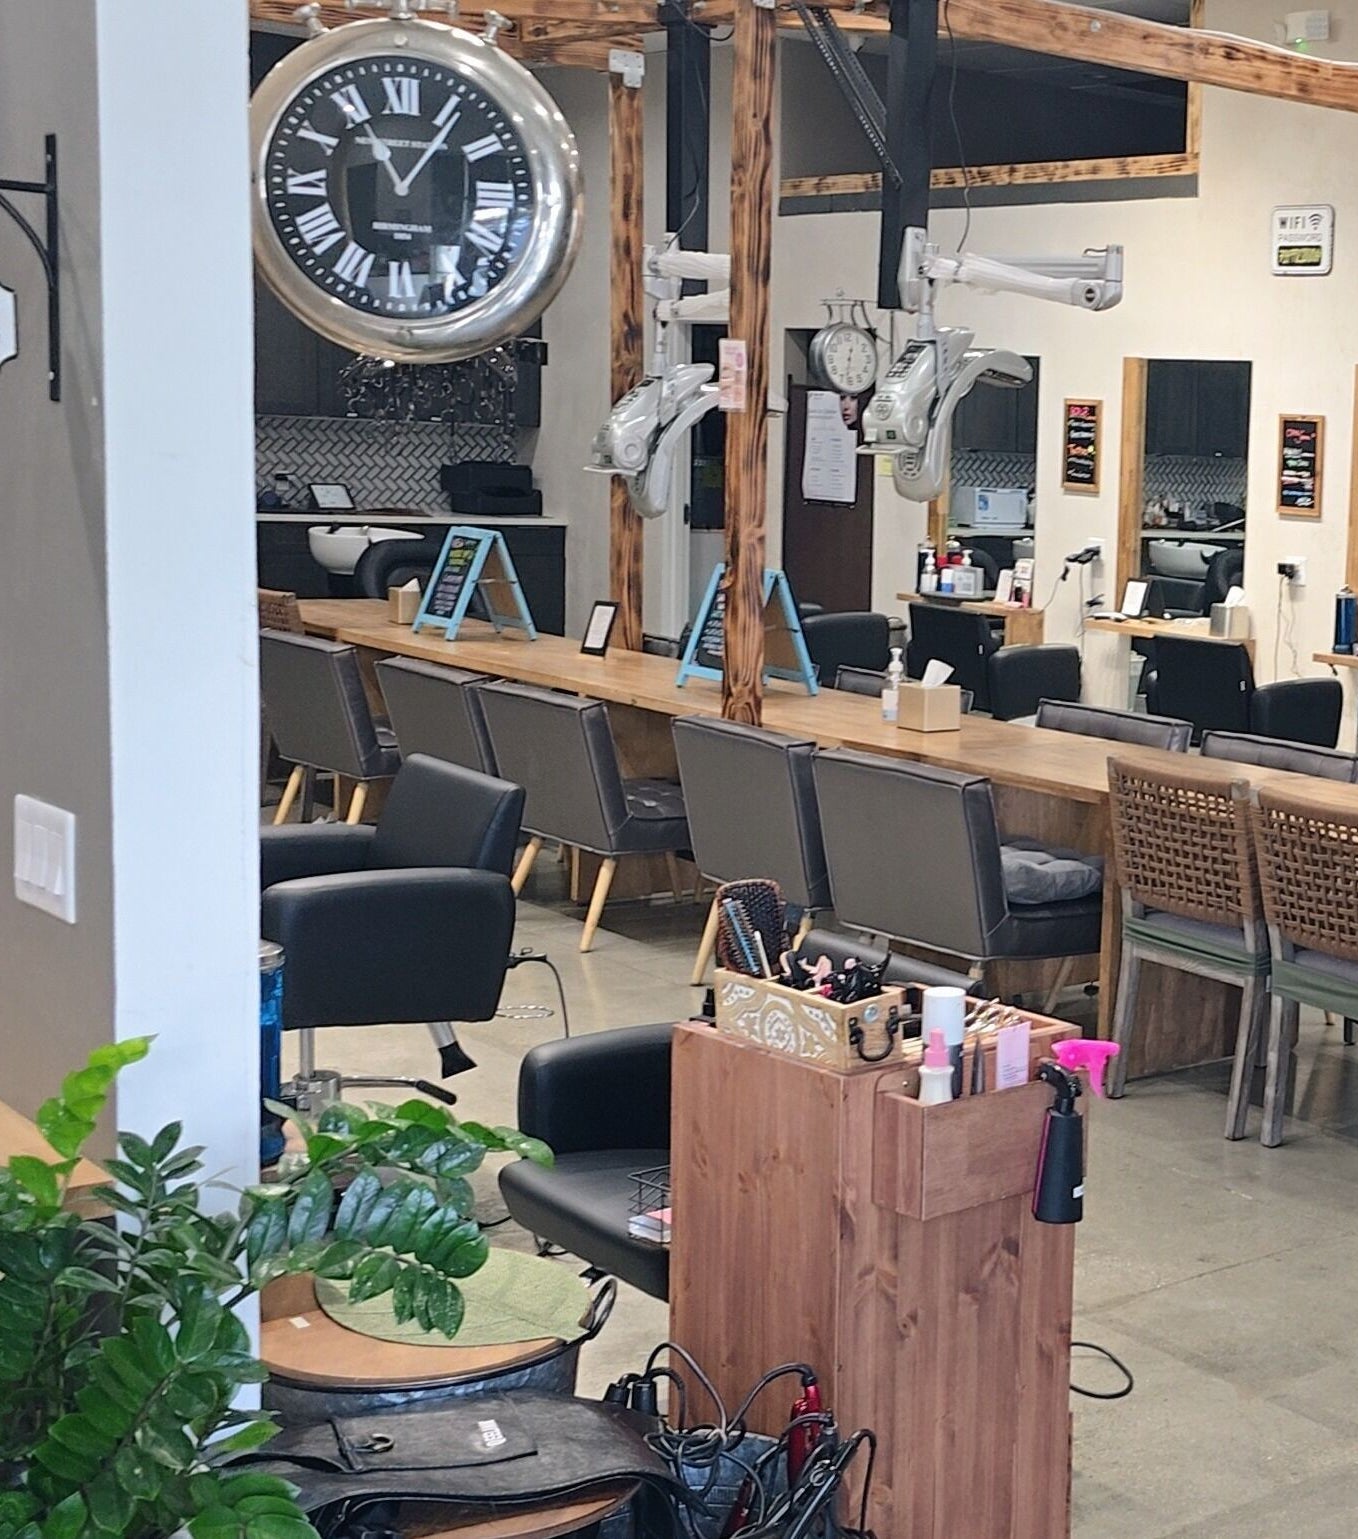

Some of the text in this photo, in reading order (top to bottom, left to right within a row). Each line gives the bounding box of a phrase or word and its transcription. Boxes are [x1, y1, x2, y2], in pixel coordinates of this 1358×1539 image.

[330, 84, 372, 129] XI
[381, 77, 421, 116] XII
[432, 94, 461, 127] I
[296, 119, 339, 156] X
[461, 133, 504, 163] II
[286, 168, 328, 197] IX
[475, 180, 515, 209] III
[294, 202, 346, 256] VIII
[1279, 215, 1306, 230] WIFI
[331, 241, 376, 288] VII
[387, 260, 417, 299] VI
